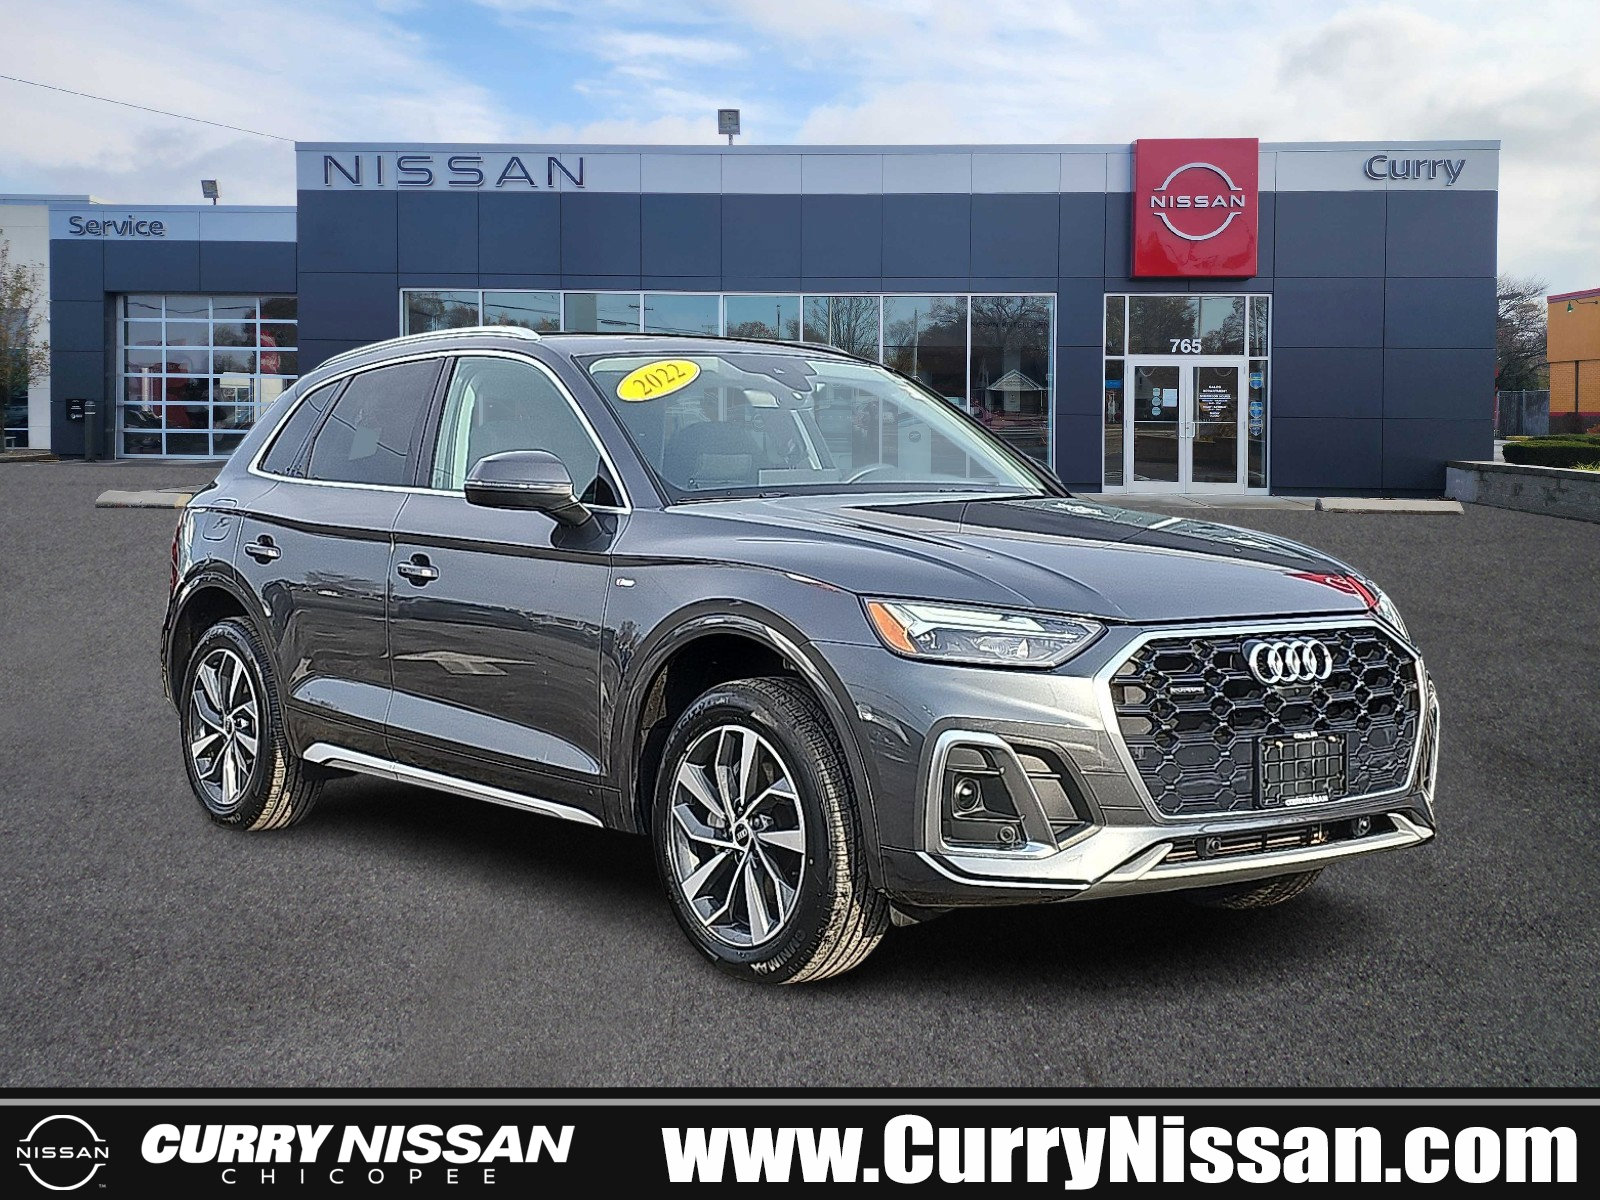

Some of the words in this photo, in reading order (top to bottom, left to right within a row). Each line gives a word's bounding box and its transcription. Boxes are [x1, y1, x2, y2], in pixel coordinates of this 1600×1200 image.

[323, 154, 586, 189] NISSAN
[1364, 154, 1467, 187] Curry
[1150, 194, 1246, 209] NISSAN
[68, 214, 165, 237] Service
[1169, 338, 1202, 354] 765
[632, 363, 686, 395] 2022
